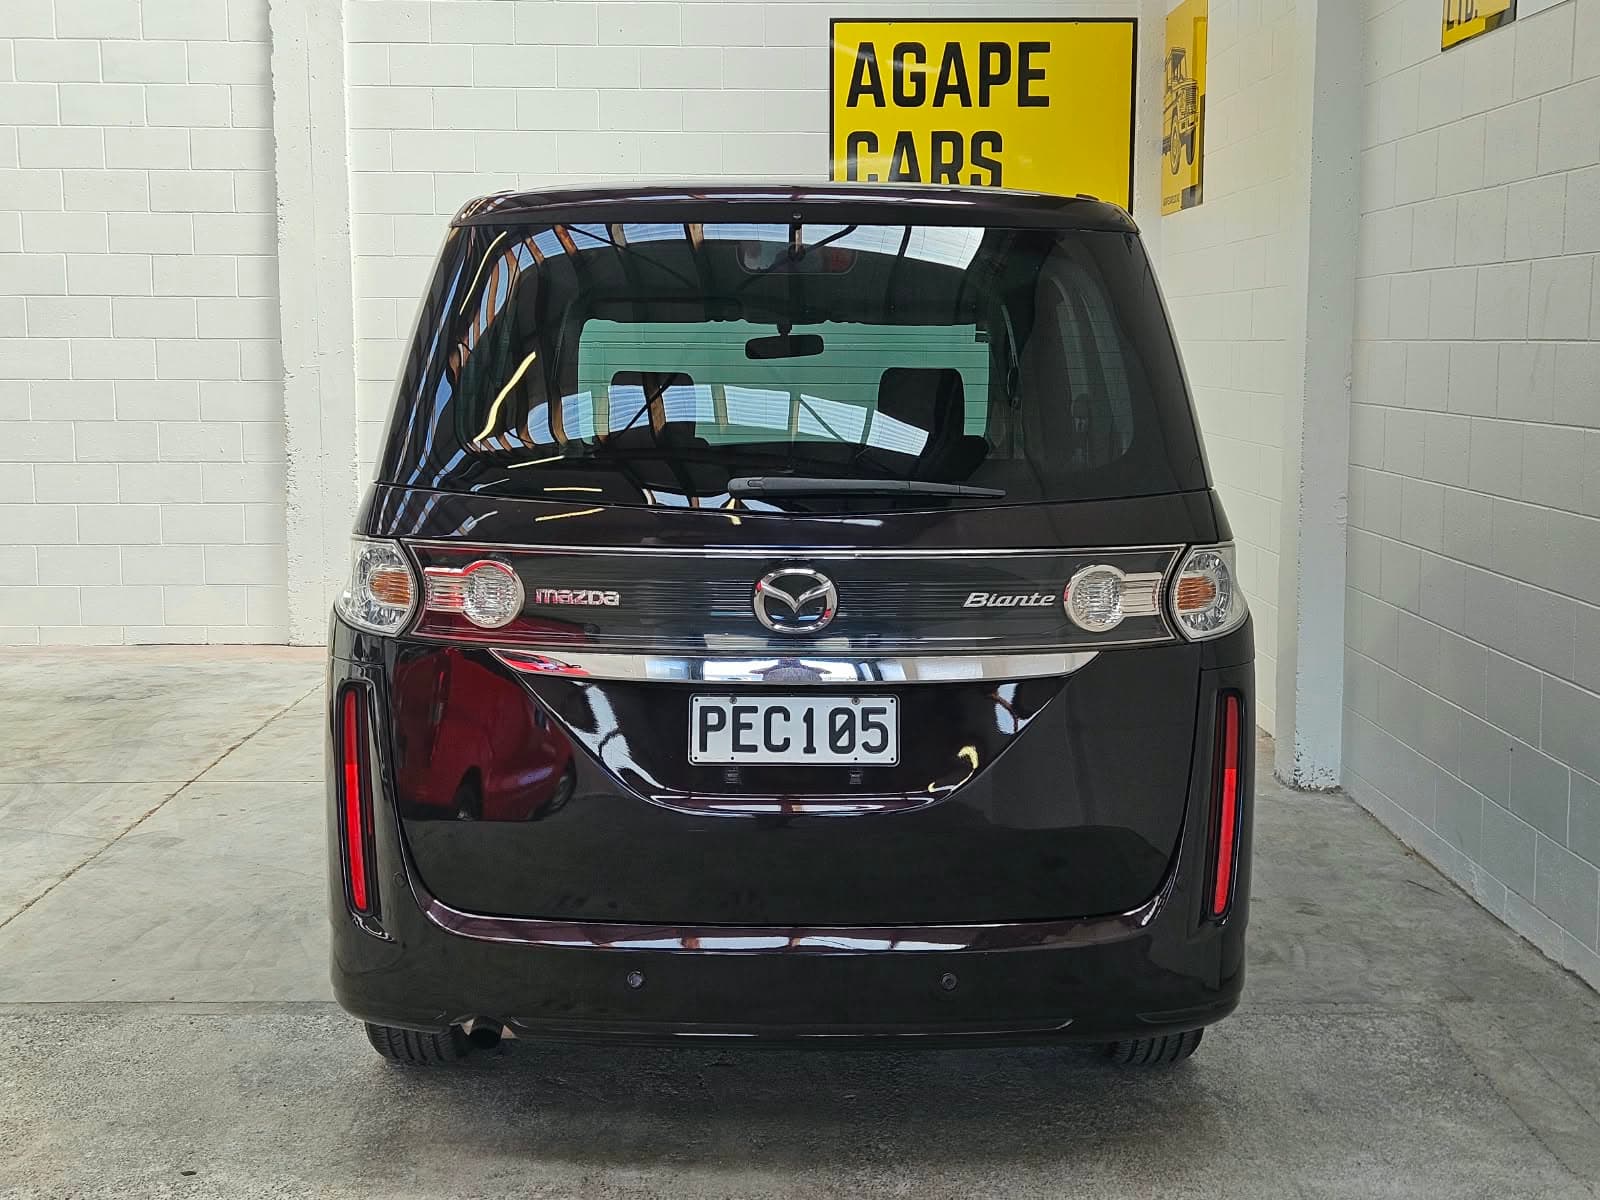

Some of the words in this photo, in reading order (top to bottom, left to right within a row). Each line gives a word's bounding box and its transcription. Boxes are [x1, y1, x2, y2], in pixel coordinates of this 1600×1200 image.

[846, 41, 1051, 108] AGAPE
[846, 130, 1003, 187] CARS
[535, 588, 620, 606] mazda
[963, 592, 1056, 608] Biante
[699, 705, 889, 755] PEC105
